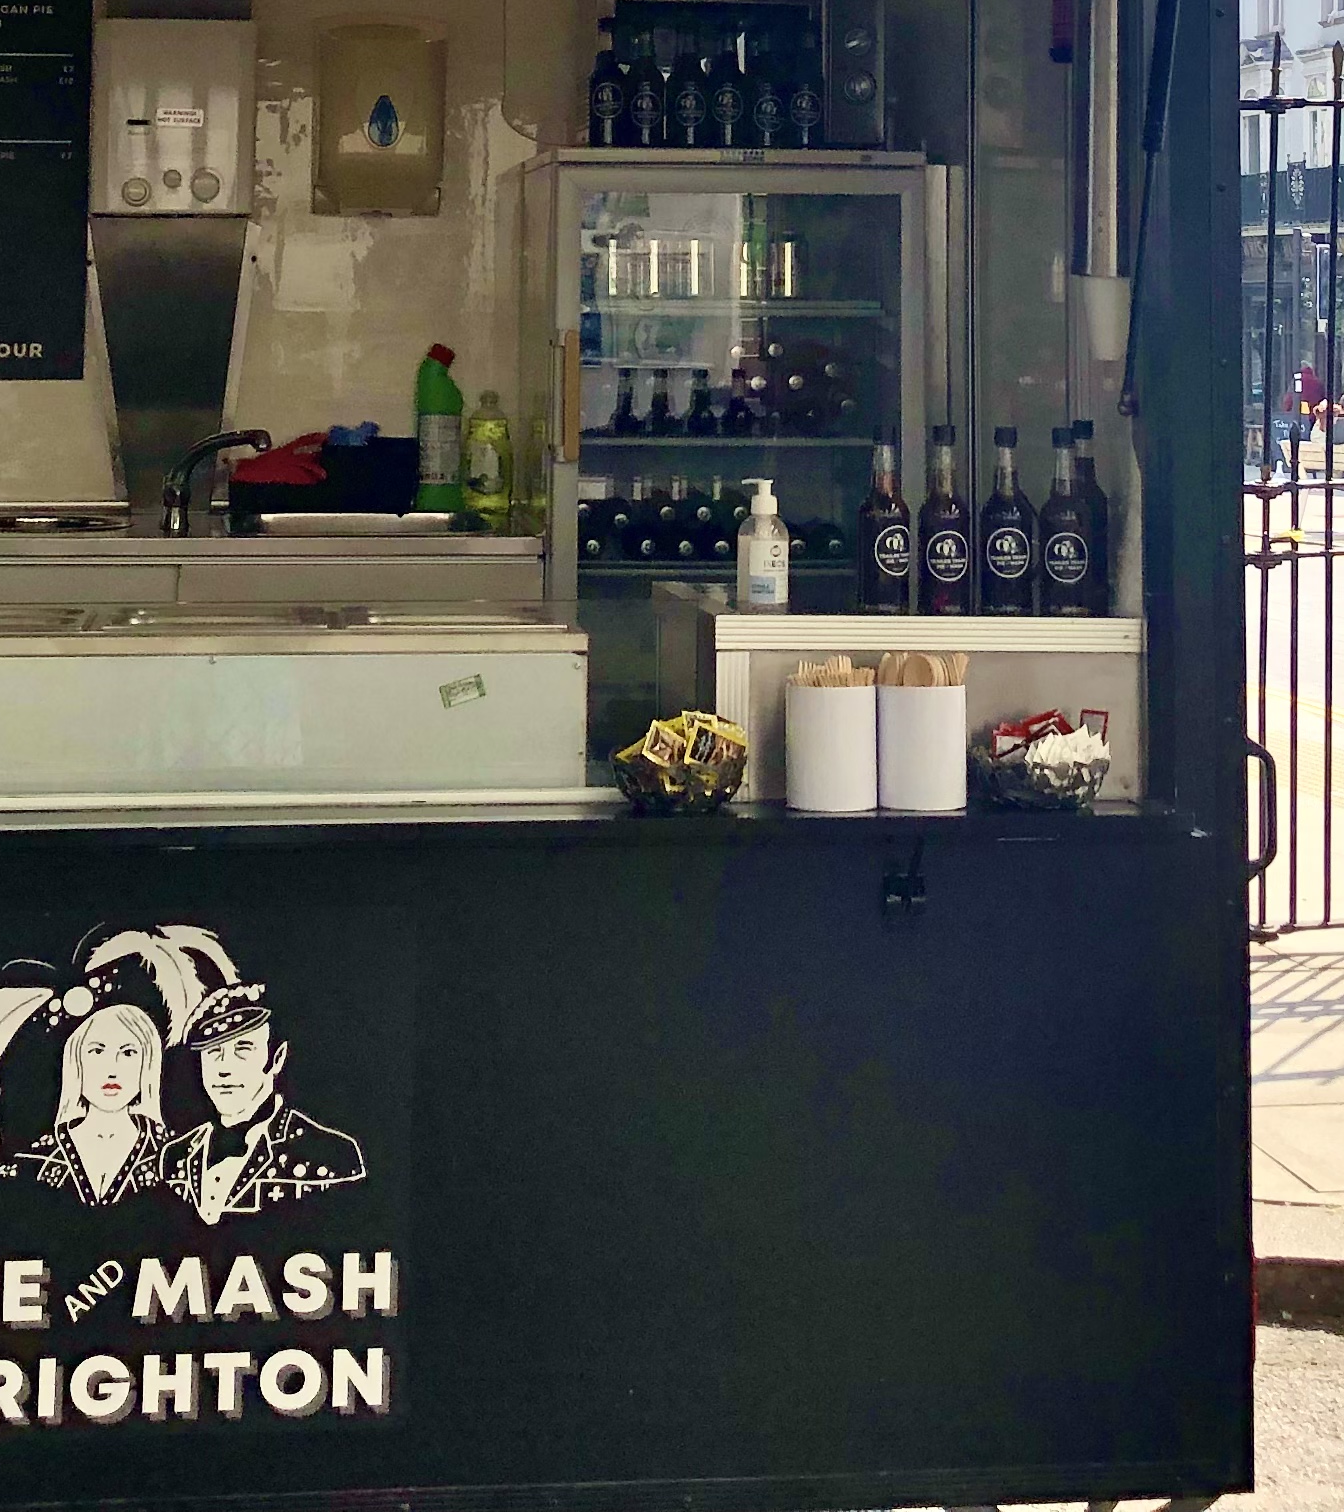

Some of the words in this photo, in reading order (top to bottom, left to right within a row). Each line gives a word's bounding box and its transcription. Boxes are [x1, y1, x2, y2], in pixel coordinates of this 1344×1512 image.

[33, 3, 54, 14] PIE
[63, 1259, 125, 1324] AND
[131, 1250, 400, 1324] MASH
